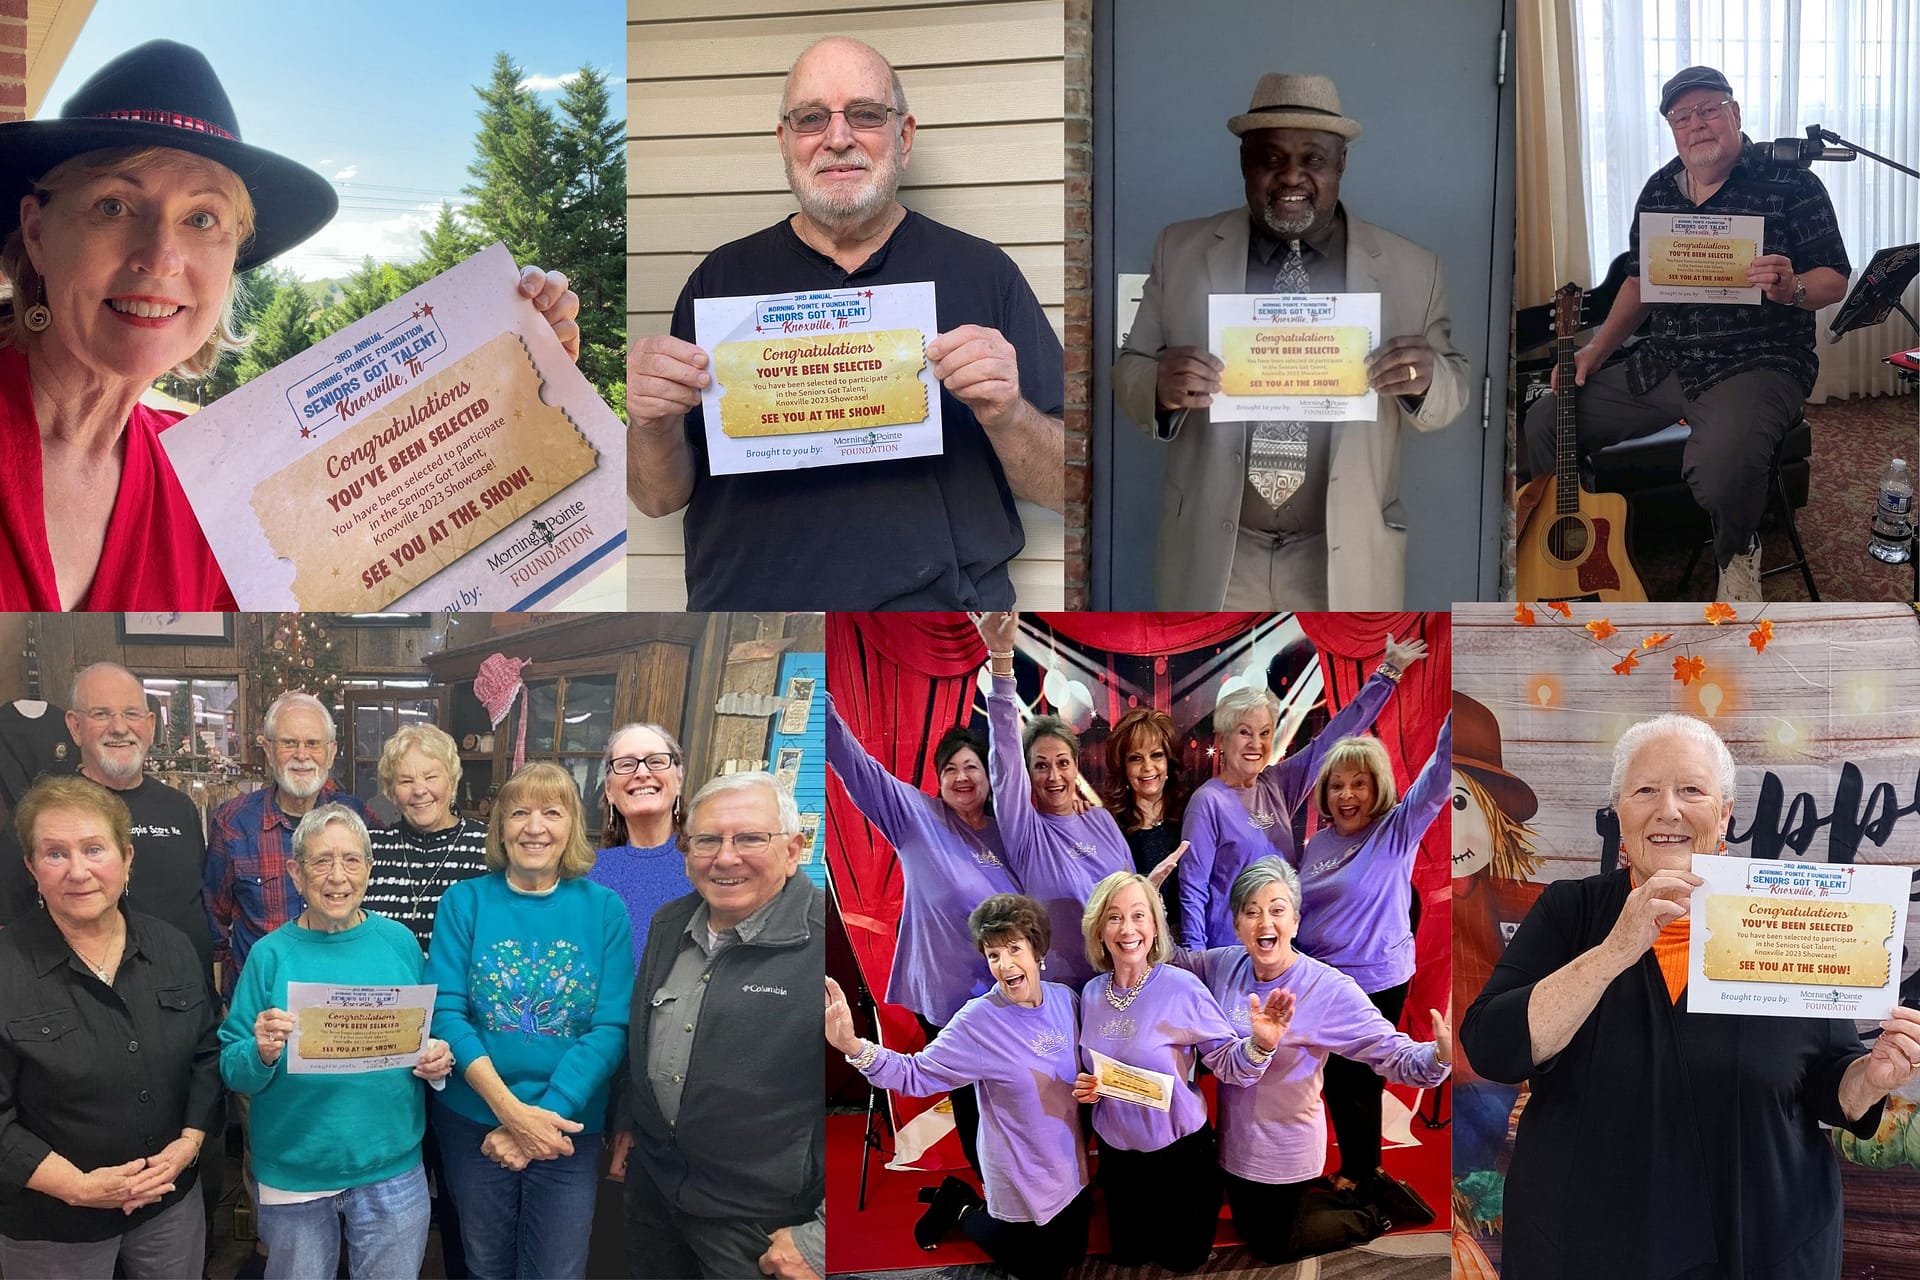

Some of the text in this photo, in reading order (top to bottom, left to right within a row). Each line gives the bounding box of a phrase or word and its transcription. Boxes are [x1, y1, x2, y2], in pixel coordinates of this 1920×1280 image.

[1672, 240, 1730, 250] Congratulations
[808, 292, 832, 300] ANNUAL
[768, 300, 860, 312] MORNING POINTE FOUNDATION
[762, 307, 867, 323] SENIORS GOT TALENT
[782, 316, 850, 334] Knoxville, Tn
[1256, 332, 1335, 346] Congratulations
[335, 332, 384, 364] 3RD ANNUAL
[762, 341, 876, 364] Congratulations
[1250, 346, 1280, 354] YOU'VE
[1304, 346, 1340, 354] SELECTED
[306, 324, 424, 399] MORNING POINTE FOUNDATION
[756, 359, 882, 379] YOU'VE BEEN SELECTED
[303, 331, 438, 419] SENIORS GOT TALENT
[753, 382, 767, 391] You
[768, 380, 786, 390] have
[788, 380, 805, 388] been
[806, 378, 837, 388] selected
[848, 374, 888, 387] participate
[336, 356, 425, 421] Knoxville, Tn
[798, 388, 826, 396] Seniors
[828, 386, 842, 394] Got
[842, 384, 867, 394] Talent,
[776, 394, 869, 407] Knoxville 2023 Showcase!
[761, 404, 886, 424] SEE YOU AT THE SHOW!
[326, 380, 471, 479] Congratulations
[834, 431, 902, 446] Morning Pointe
[326, 398, 490, 514] YOU'VE BEEN SELECTED
[746, 446, 824, 460] Brought to you by:
[841, 444, 898, 457] FOUNDATION
[331, 417, 506, 538] You have been selected to participate
[368, 449, 487, 531] in the Seniors Got Talent,
[373, 458, 497, 546] Knoxville 2023 Showcase!
[362, 465, 535, 590] SEE YOU AT THE SHOW!
[486, 499, 586, 572] Morning Pointe
[510, 524, 595, 588] FOUNDATION
[460, 586, 482, 607] by:
[1753, 876, 1848, 889] SENIORS GOT TALENT
[1769, 884, 1829, 898] Knoxville, Tn
[1748, 903, 1849, 920] Congratulations
[1742, 918, 1854, 932] YOU'VE BEEN SELECTED
[1776, 941, 1800, 950] Seniors
[1814, 943, 1836, 952] Talent,
[1784, 934, 1812, 942] selected
[1822, 935, 1857, 944] participate
[1802, 951, 1838, 959] Showcase!
[1739, 960, 1850, 975] SEE YOU AT THE SHOW!
[750, 984, 788, 996] Columbia
[1800, 990, 1863, 1000] Morning Pointe
[1720, 992, 1790, 1004] Brought to you by:
[1805, 1003, 1858, 1012] FOUNDATION
